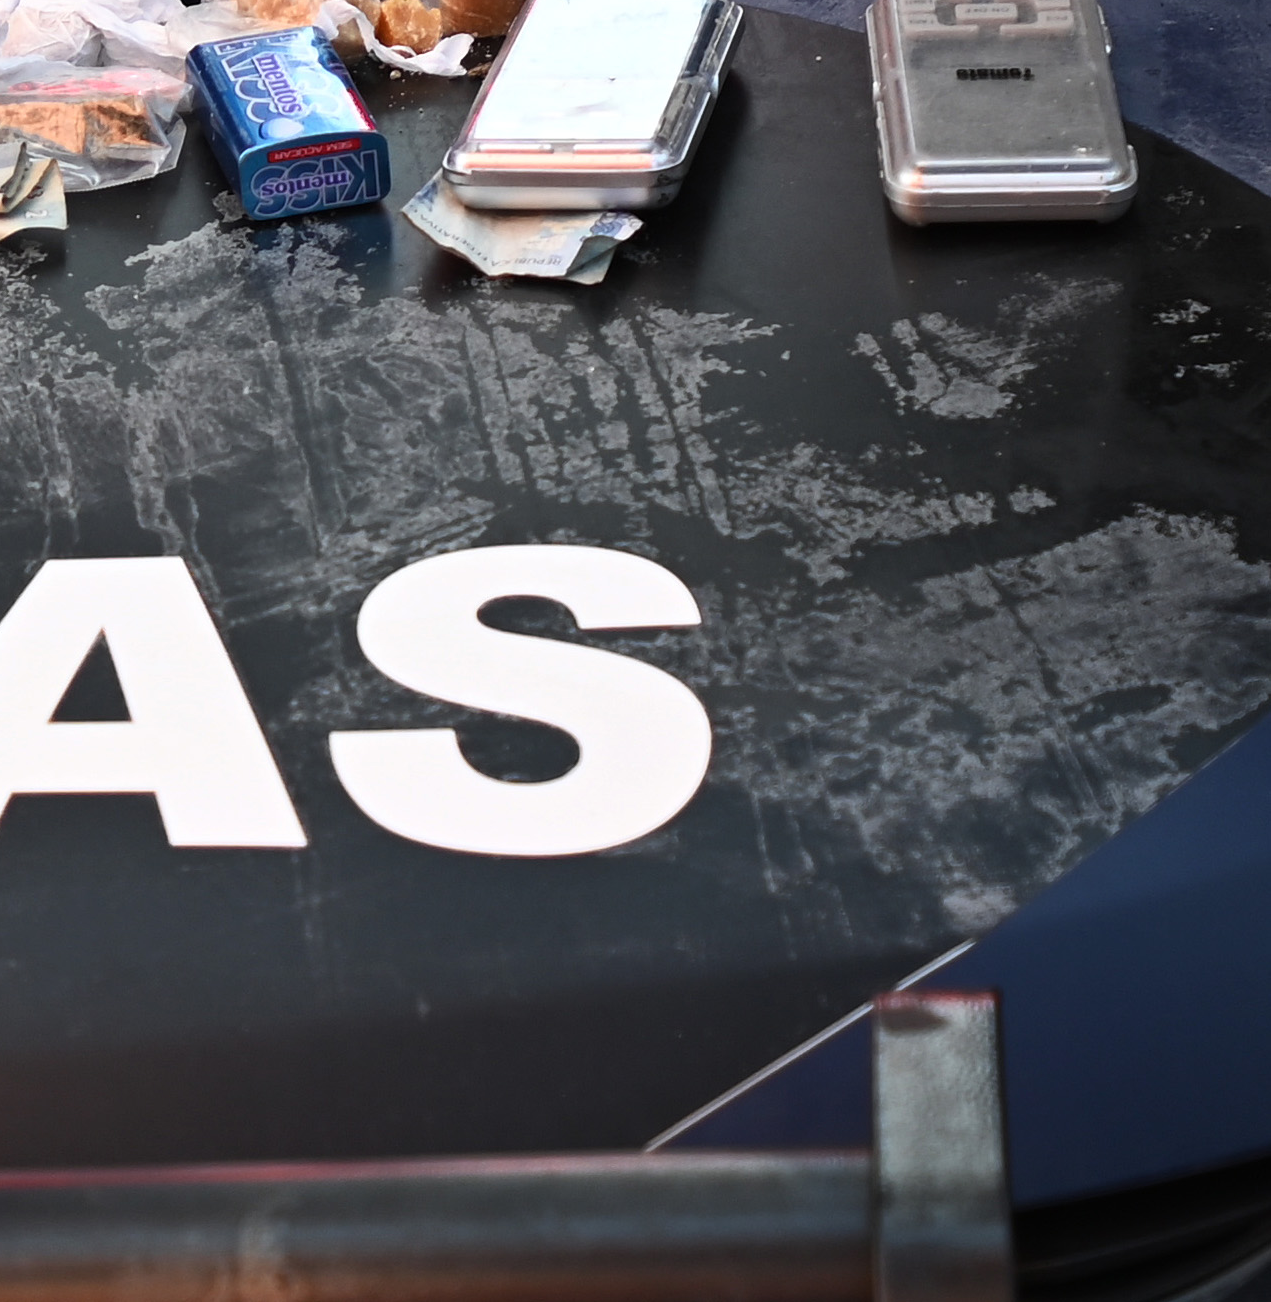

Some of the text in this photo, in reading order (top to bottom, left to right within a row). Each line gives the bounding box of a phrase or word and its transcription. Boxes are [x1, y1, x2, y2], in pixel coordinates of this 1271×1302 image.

[257, 53, 304, 116] mentos
[325, 140, 354, 151] SEM
[251, 149, 381, 217] KISS
[260, 170, 351, 197] mentos
